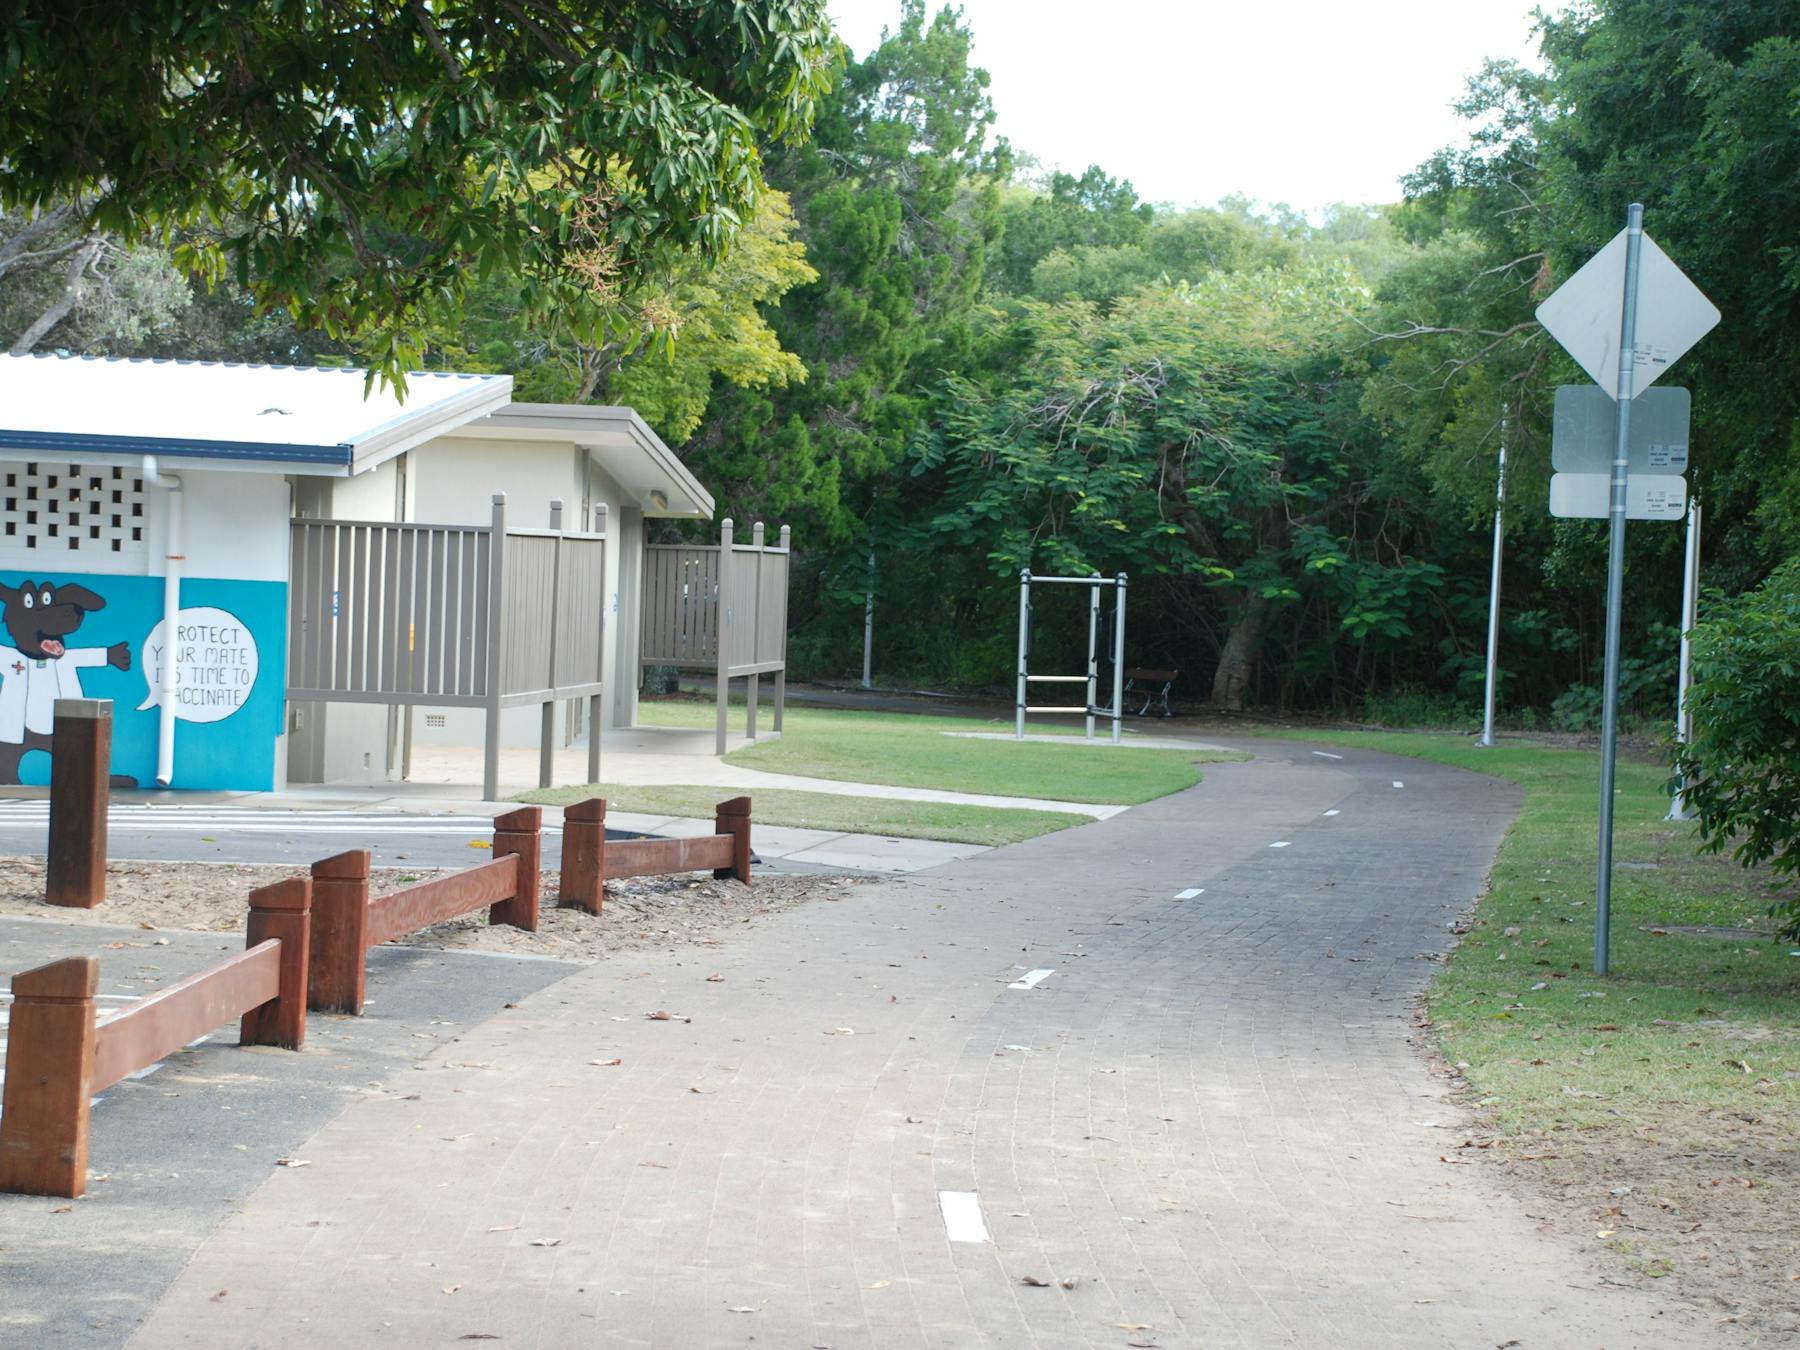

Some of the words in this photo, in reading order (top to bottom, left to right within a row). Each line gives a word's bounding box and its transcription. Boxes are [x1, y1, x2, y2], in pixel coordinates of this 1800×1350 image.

[178, 625, 240, 644] ROTECT
[152, 645, 195, 663] YUR
[205, 647, 249, 665] MATE
[191, 667, 227, 685] TIME
[232, 668, 250, 685] TO
[175, 687, 241, 706] ACCINATE
